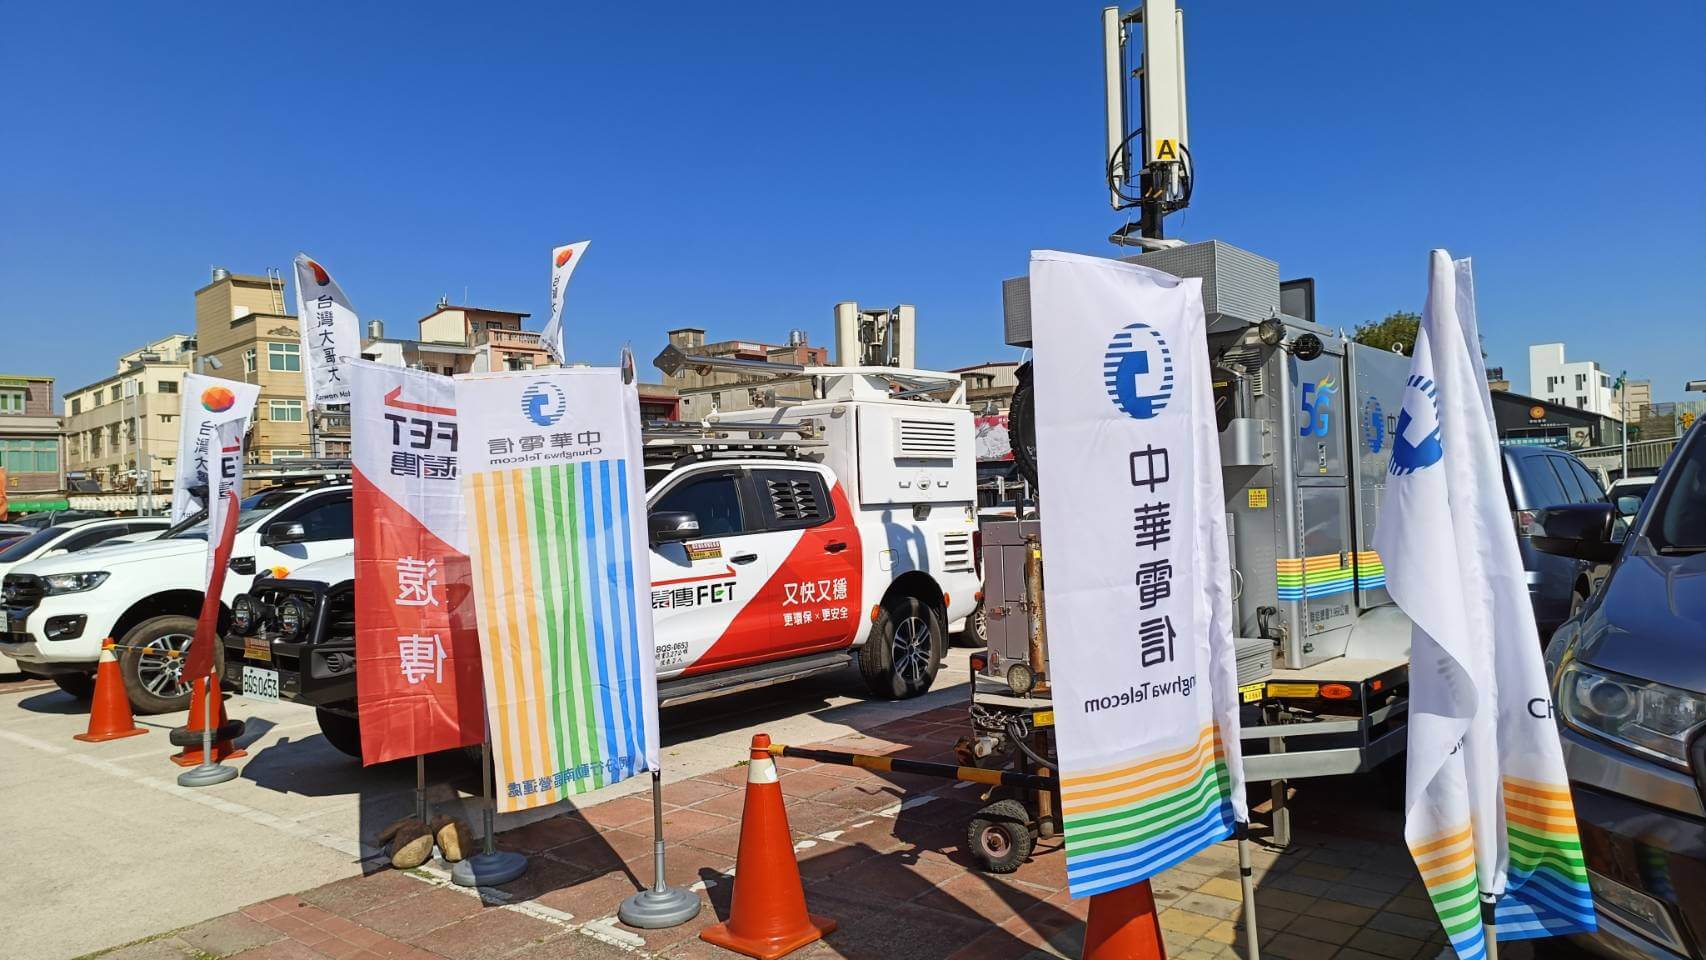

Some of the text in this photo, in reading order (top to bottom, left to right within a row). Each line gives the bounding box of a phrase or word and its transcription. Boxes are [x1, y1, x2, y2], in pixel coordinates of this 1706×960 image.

[1157, 140, 1176, 160] A
[316, 294, 341, 383] 台灣大哥大
[1299, 380, 1331, 437] 5G
[697, 581, 737, 605] FET
[782, 578, 848, 607] 又快又穩
[822, 606, 848, 622] 更安全
